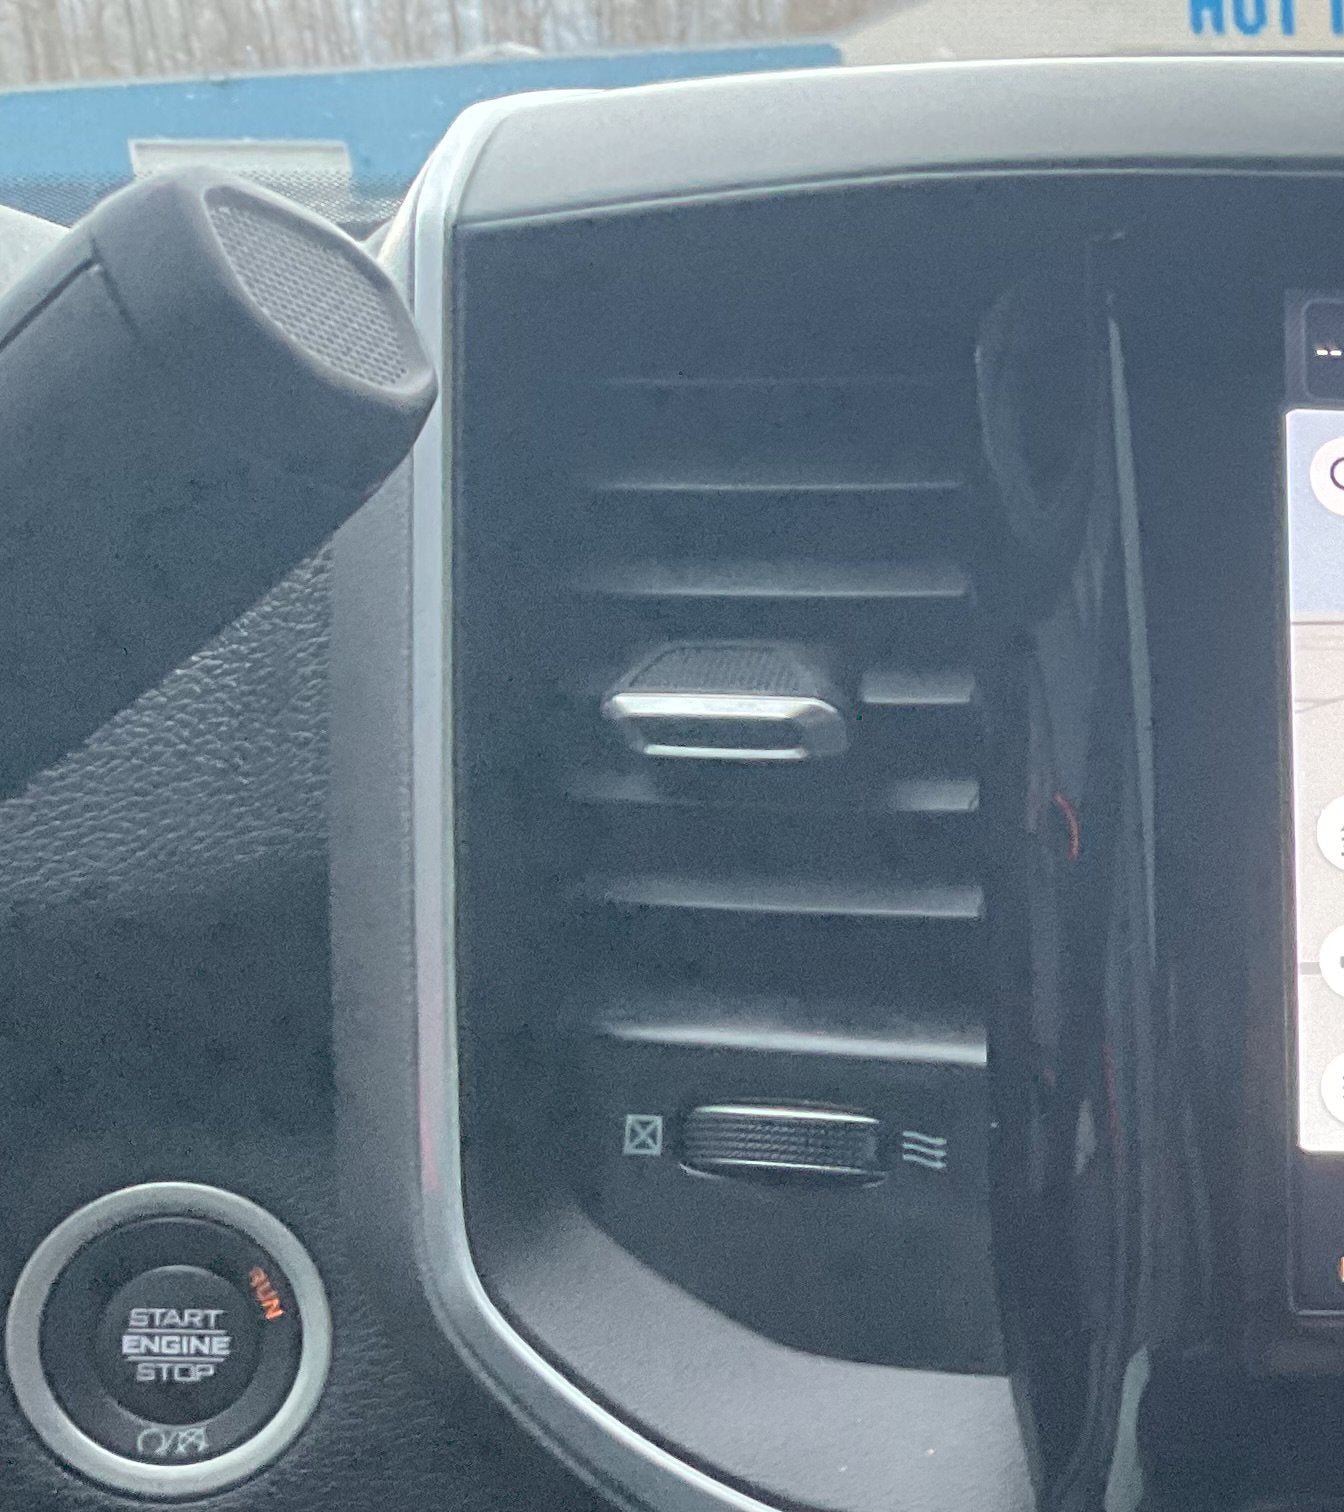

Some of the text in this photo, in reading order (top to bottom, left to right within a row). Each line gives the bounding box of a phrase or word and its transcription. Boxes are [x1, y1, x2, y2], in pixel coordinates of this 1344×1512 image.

[129, 1308, 225, 1328] START
[122, 1335, 232, 1355] ENGINE
[136, 1363, 215, 1382] STOP
